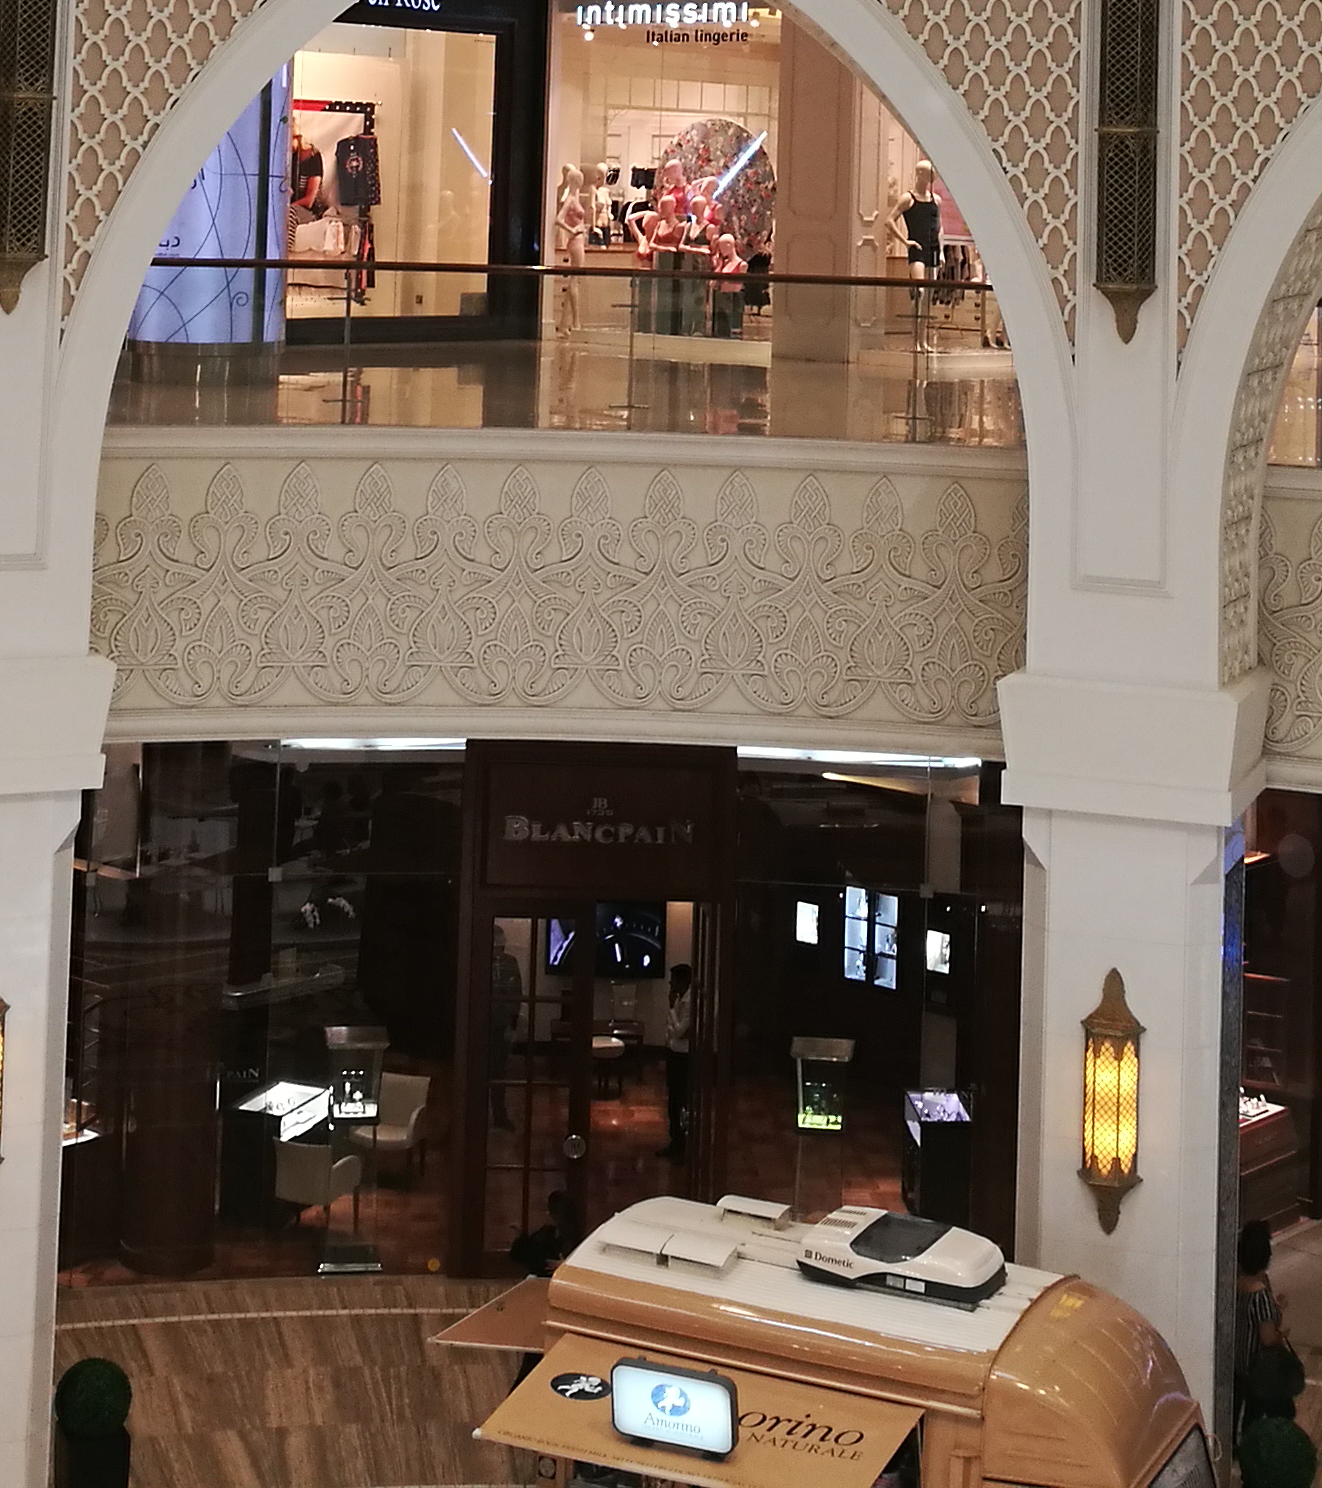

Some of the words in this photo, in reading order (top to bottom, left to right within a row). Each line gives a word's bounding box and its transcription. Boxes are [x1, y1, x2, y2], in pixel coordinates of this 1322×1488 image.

[576, 0, 749, 26] intimissimi
[646, 29, 690, 44] Italian
[694, 29, 749, 46] lingerie
[503, 815, 694, 845] BLANCPAIN
[813, 1250, 855, 1270] Dometic
[643, 1411, 702, 1435] Amorino
[745, 1431, 865, 1462] NATURALE
